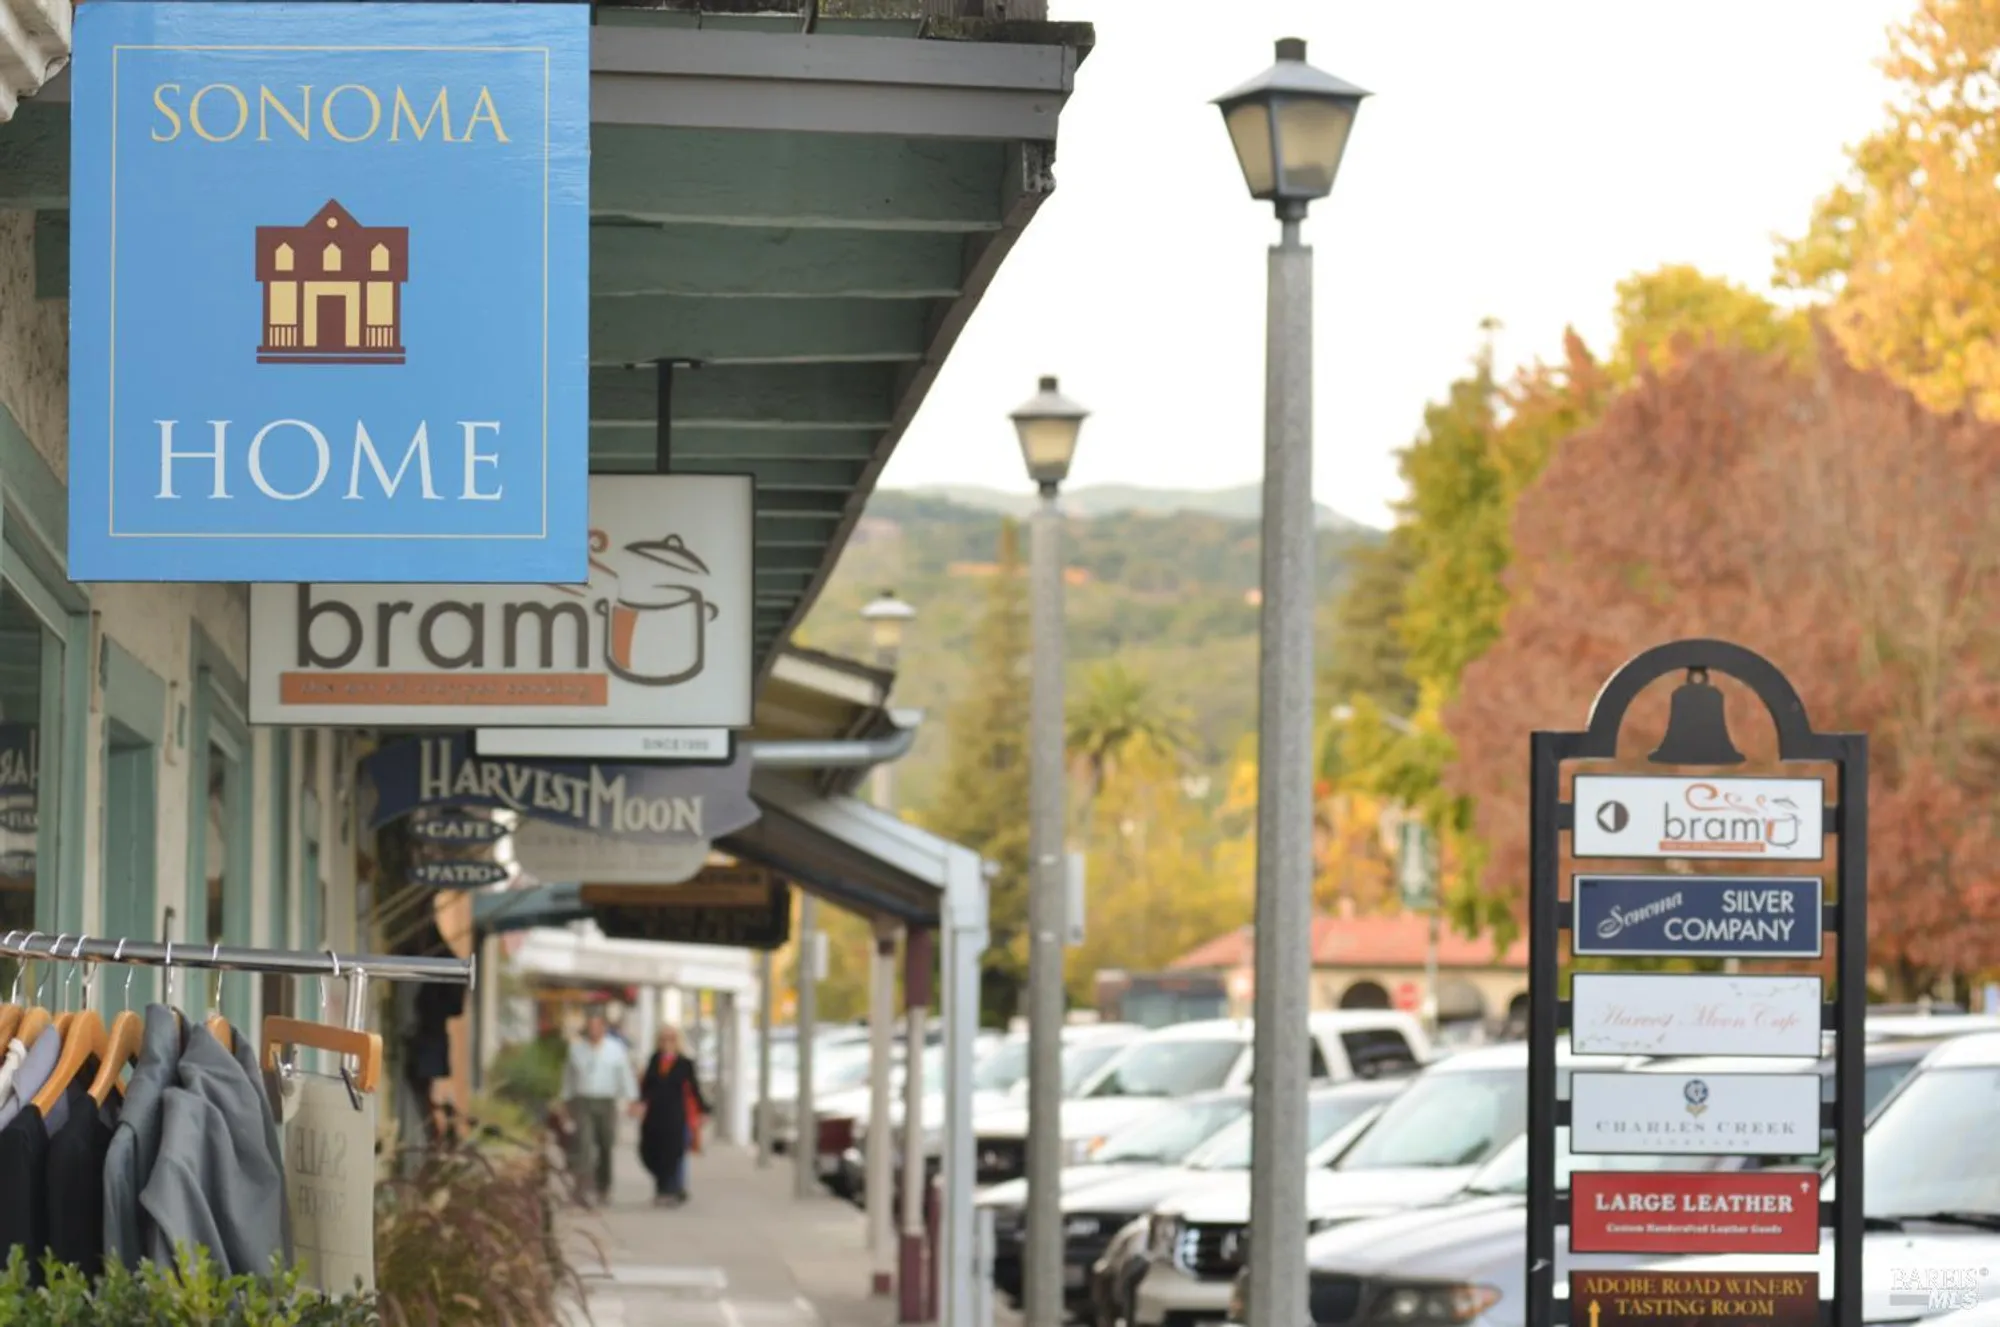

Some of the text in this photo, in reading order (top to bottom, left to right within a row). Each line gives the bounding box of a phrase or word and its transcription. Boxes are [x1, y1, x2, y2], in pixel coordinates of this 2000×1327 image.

[151, 83, 511, 143] SONOMA
[154, 418, 503, 501] HOME
[297, 582, 590, 669] bram
[420, 738, 705, 836] HARVEST MOON
[426, 820, 490, 839] CAFE
[1663, 801, 1761, 840] bram
[427, 863, 493, 882] PATIO
[1721, 889, 1795, 913] SILVER
[1597, 891, 1684, 938] Sonoma
[1663, 917, 1795, 942] COMPANY
[1596, 1120, 1796, 1135] CHARLES CREEK
[1595, 1193, 1794, 1214] LARGE LEATHER
[1584, 1278, 1808, 1296] ADOBE ROAD WINERY
[1614, 1298, 1775, 1317] TASTING ROOM
